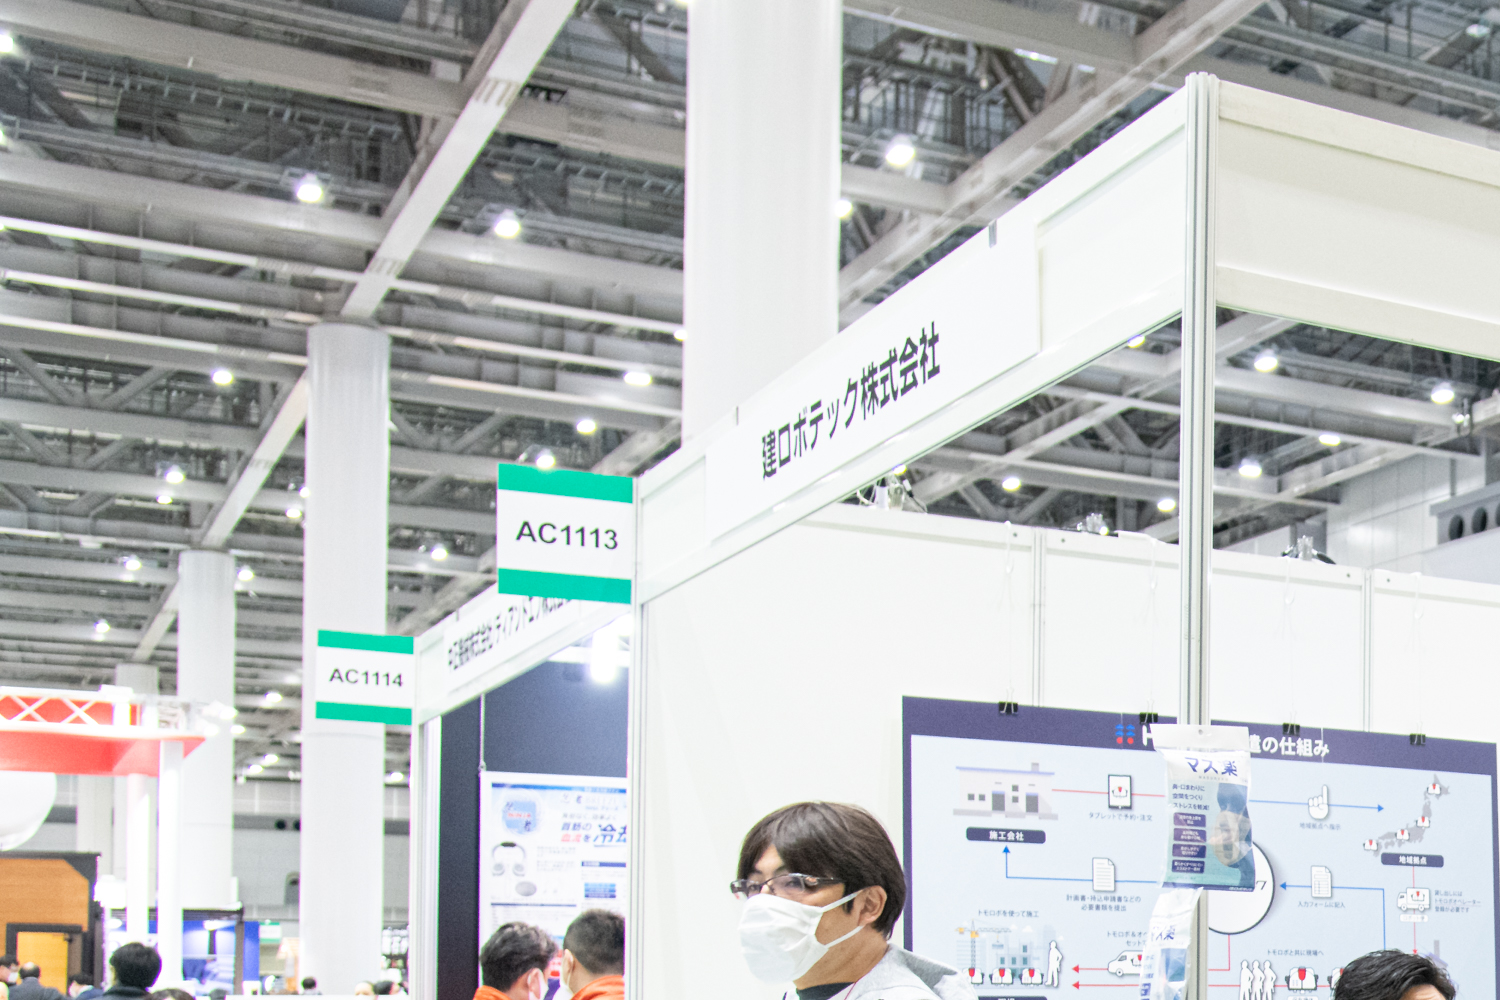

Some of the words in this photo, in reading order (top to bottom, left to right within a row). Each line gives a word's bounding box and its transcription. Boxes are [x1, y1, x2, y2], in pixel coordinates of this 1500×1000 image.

[761, 320, 941, 481] 建ロボテック株式会社
[515, 520, 619, 550] AC1113
[328, 667, 404, 687] AC1114
[1184, 756, 1238, 777] マス楽
[1299, 821, 1342, 832] 地域拠点へ指示
[988, 830, 1026, 842] 施工会社
[1398, 855, 1428, 866] 地域拠点
[1297, 900, 1347, 910] 入力フォームに記入
[977, 909, 1040, 919] トモロボを使って施工
